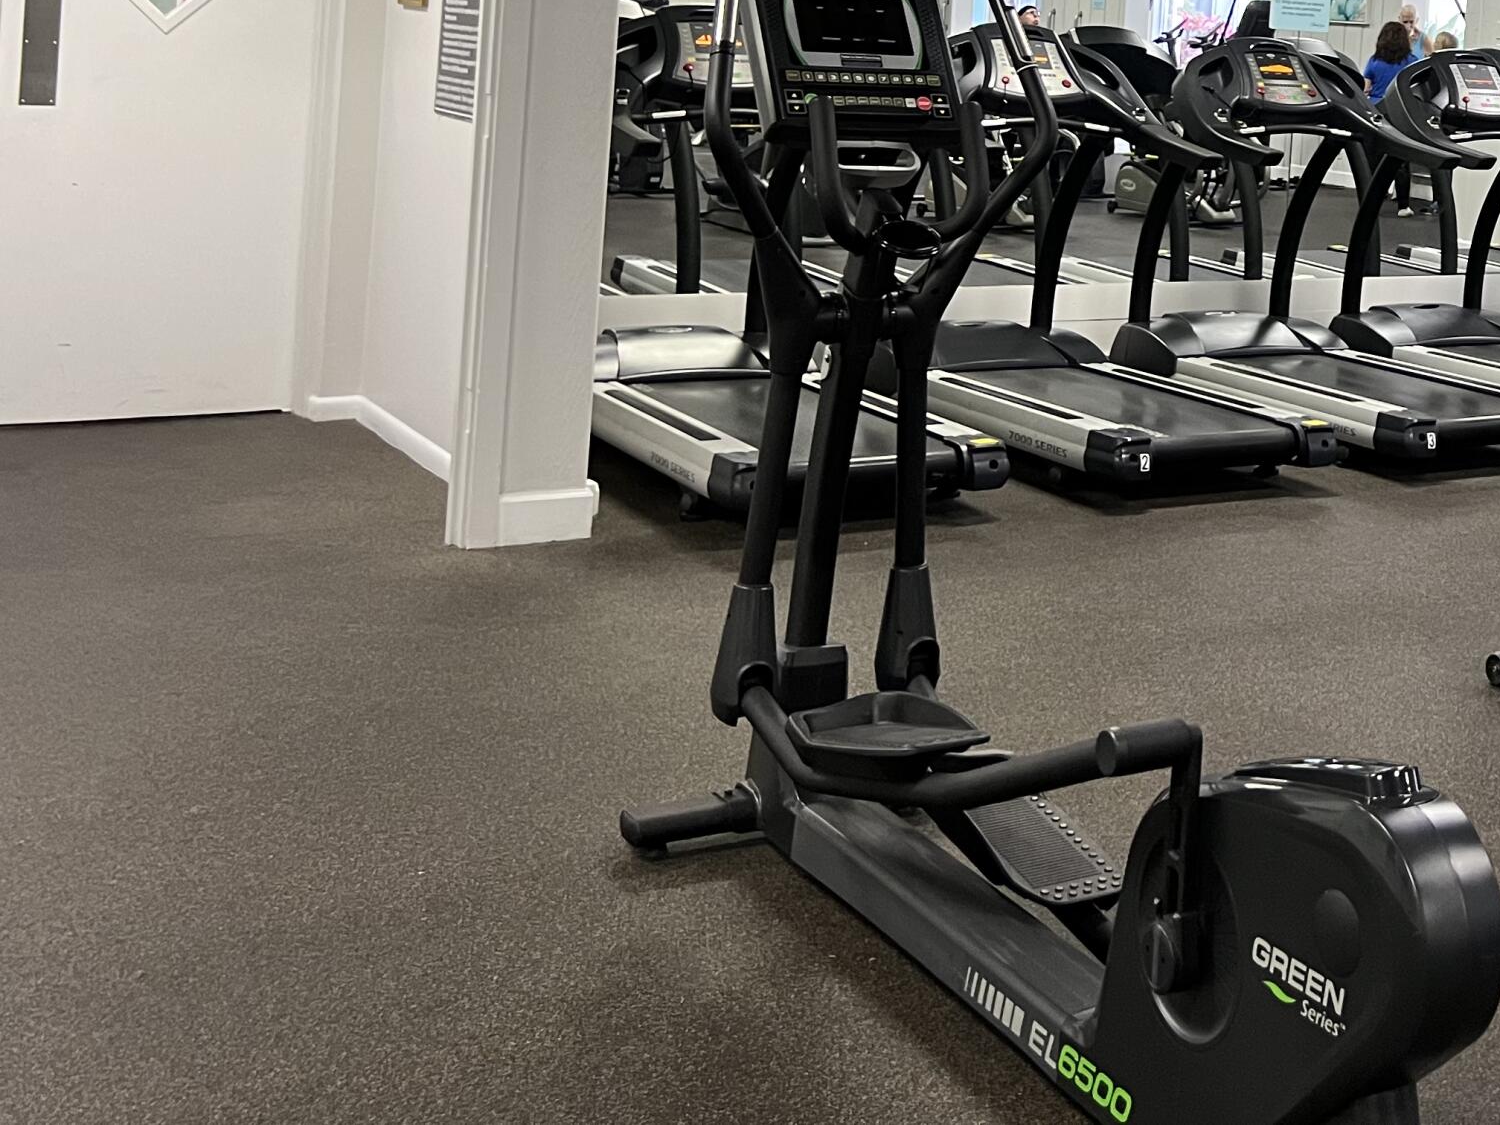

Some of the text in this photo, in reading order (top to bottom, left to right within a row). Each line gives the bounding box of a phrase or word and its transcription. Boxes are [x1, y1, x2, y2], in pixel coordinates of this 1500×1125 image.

[1008, 430, 1068, 458] 7000 SERIES
[650, 451, 695, 483] 7000 SERIES
[1141, 455, 1149, 470] 2
[1252, 937, 1345, 1016] GREEN
[1027, 1019, 1133, 1123] EL6500
